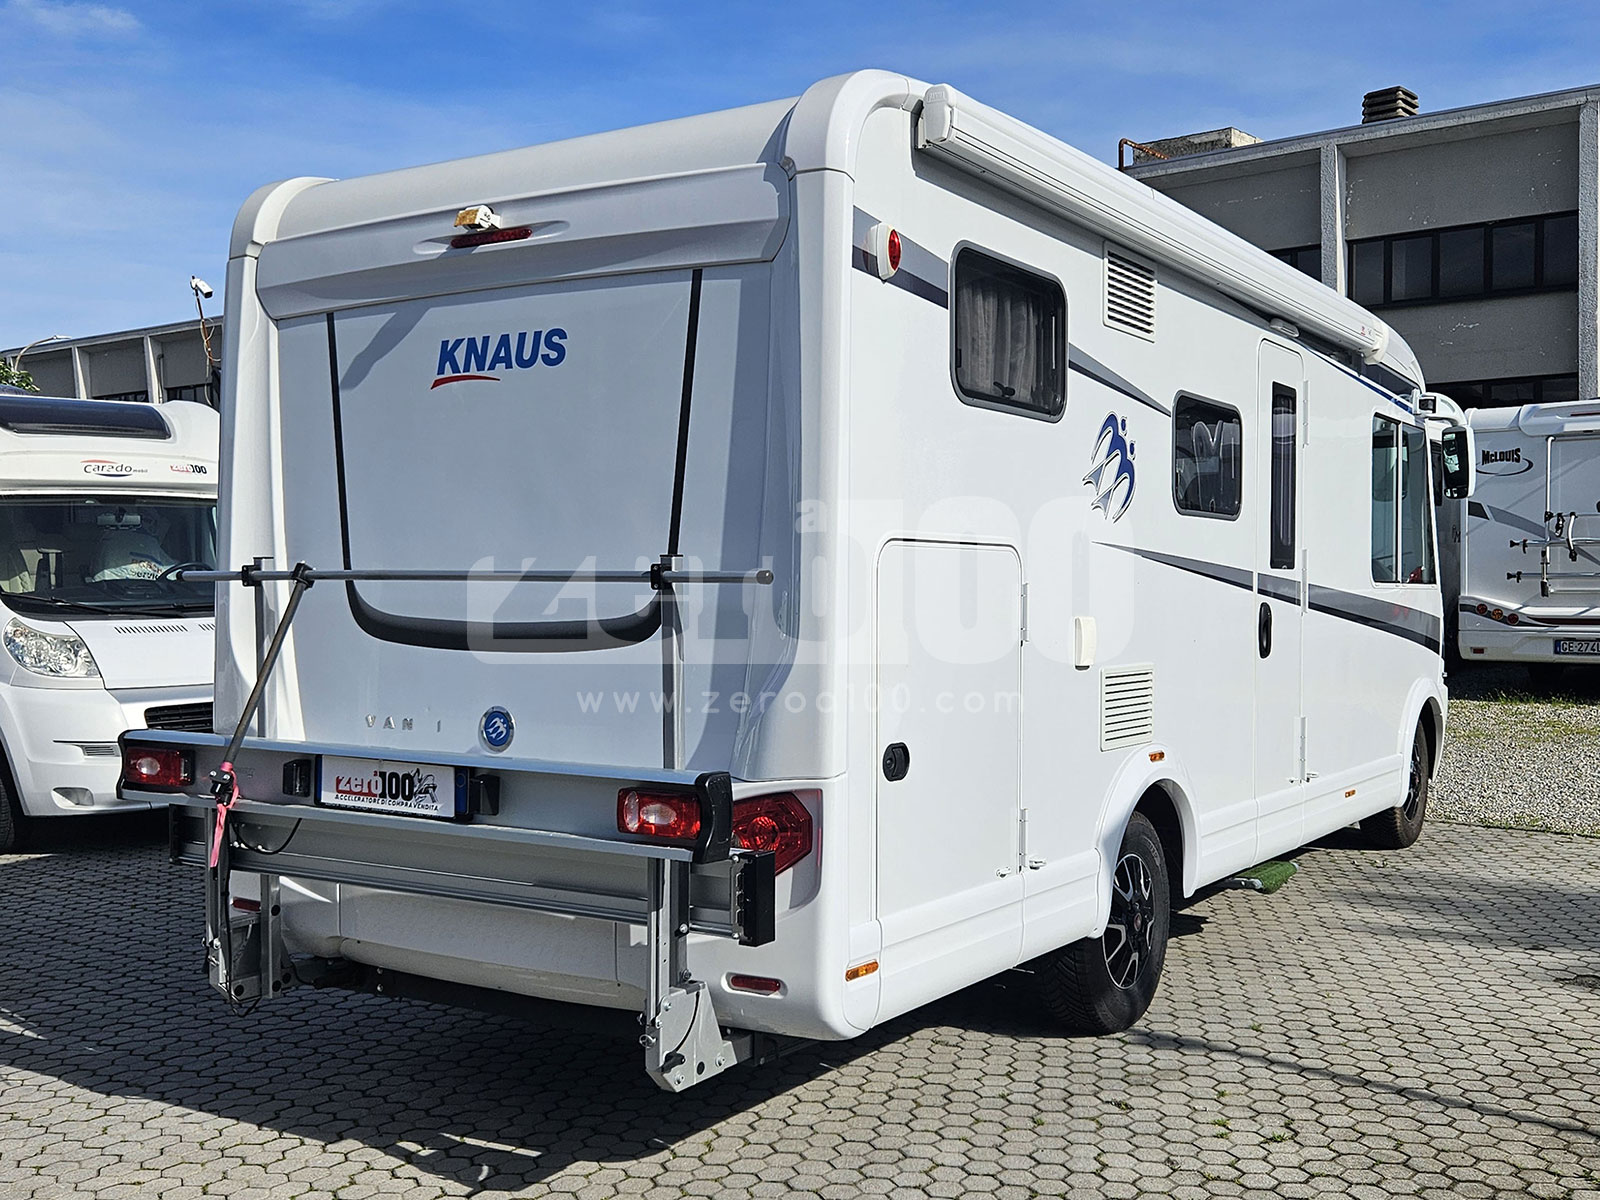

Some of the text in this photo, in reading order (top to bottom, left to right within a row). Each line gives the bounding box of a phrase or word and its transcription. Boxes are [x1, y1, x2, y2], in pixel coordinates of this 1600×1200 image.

[437, 328, 568, 376] KNAUS
[365, 713, 414, 731] VAN
[335, 794, 380, 805] ACCELERATORE
